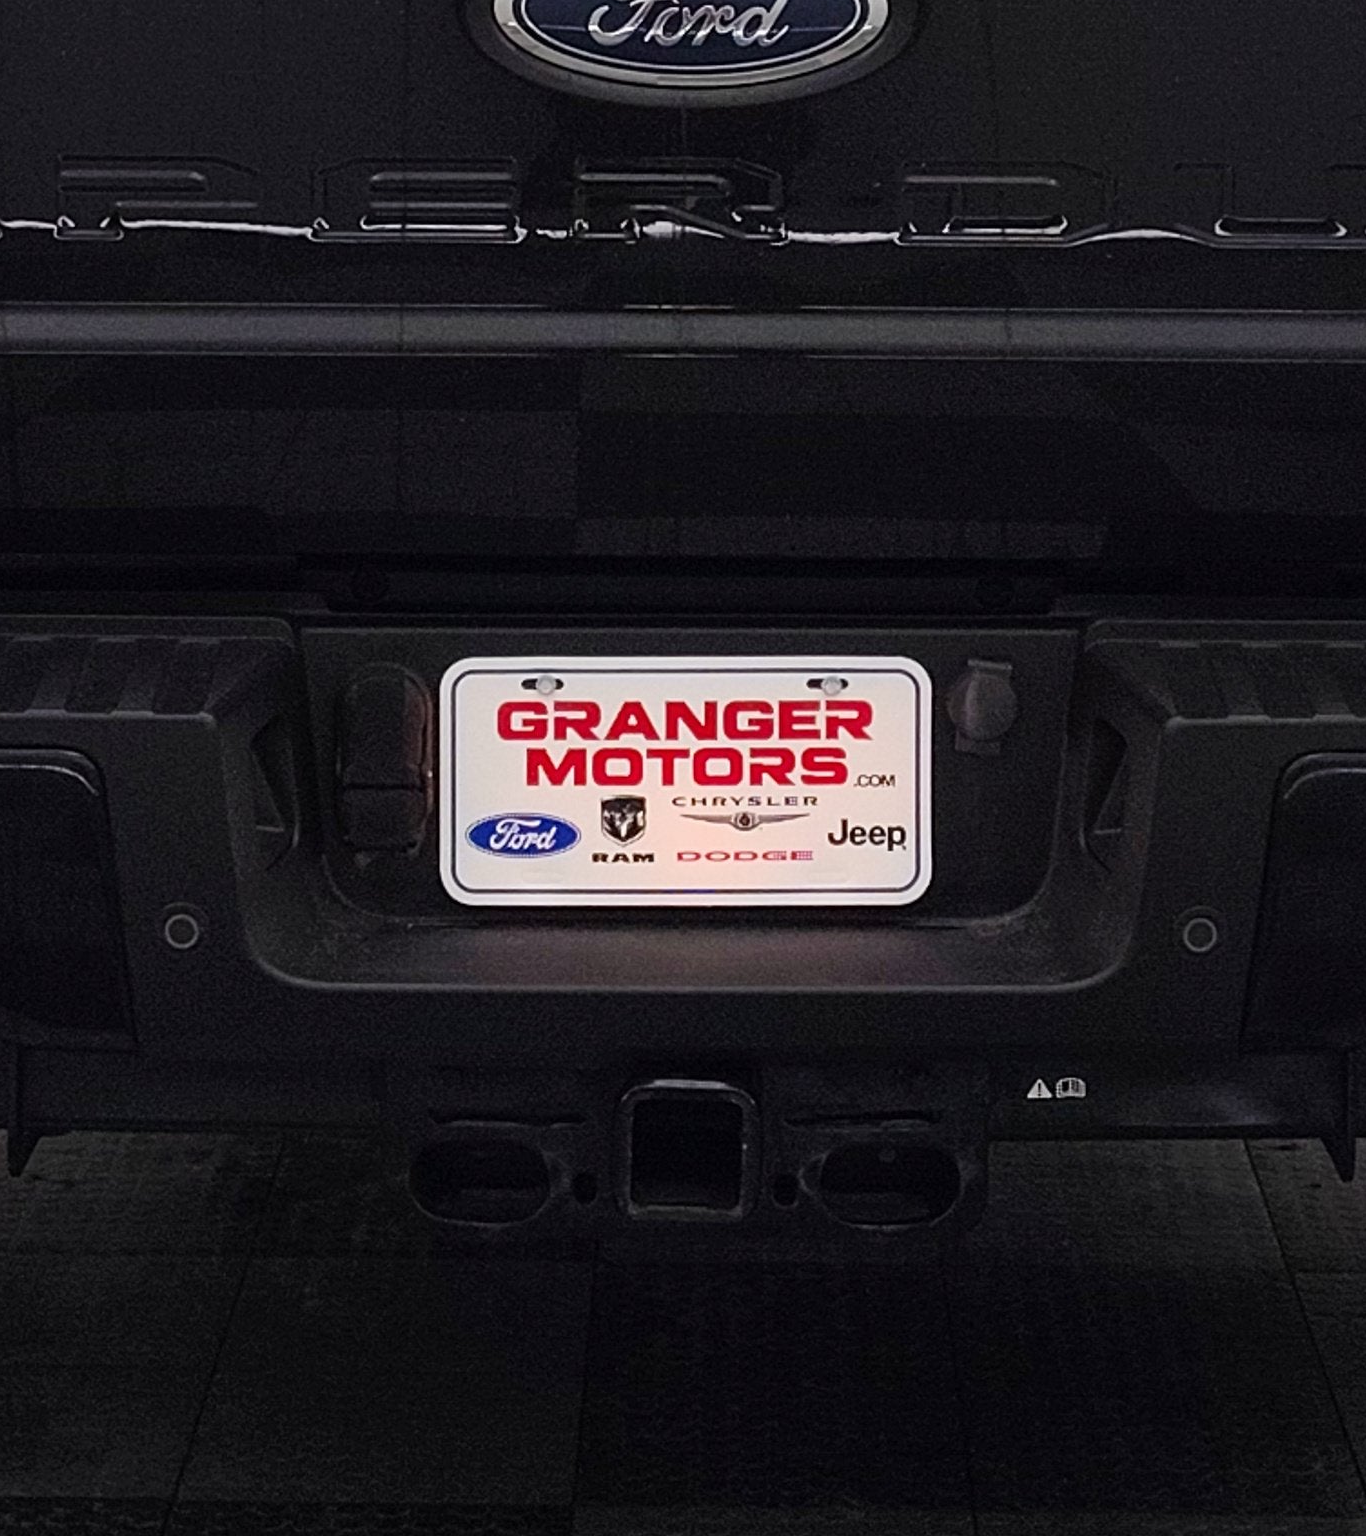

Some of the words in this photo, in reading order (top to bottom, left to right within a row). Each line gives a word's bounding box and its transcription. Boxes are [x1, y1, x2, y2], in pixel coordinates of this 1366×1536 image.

[496, 699, 874, 742] GRANGER
[525, 746, 850, 787] MOTORS
[671, 795, 819, 808] CHRYSLER
[488, 819, 557, 852] Ford
[826, 818, 908, 852] Jeep
[591, 851, 656, 864] RAM
[676, 849, 815, 862] DODGE
